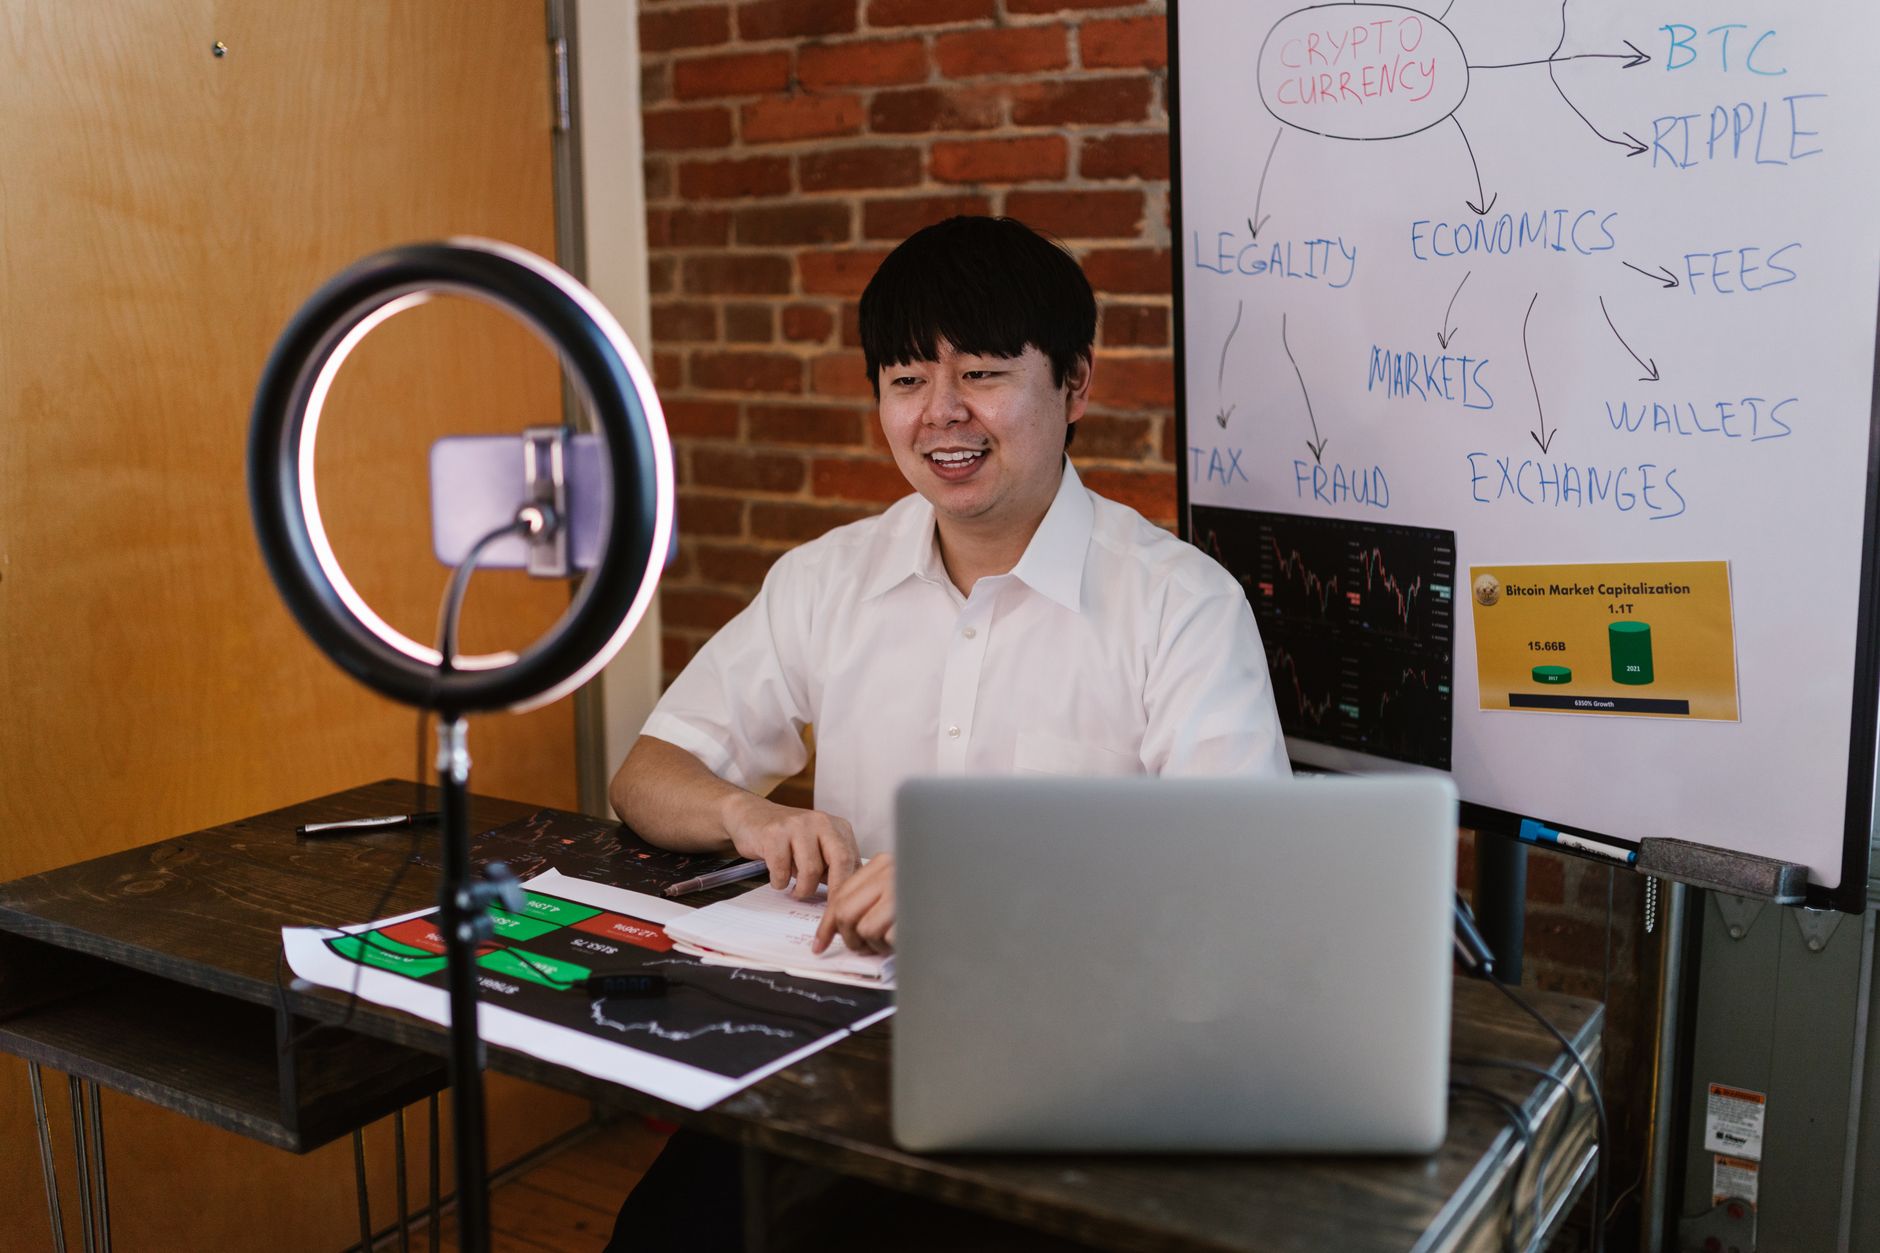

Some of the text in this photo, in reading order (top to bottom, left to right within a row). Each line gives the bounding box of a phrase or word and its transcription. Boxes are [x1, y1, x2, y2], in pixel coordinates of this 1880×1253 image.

[1281, 16, 1424, 69] CRYPTO
[1658, 23, 1788, 76] BTC
[1276, 57, 1437, 105] CURRENCY
[1652, 93, 1828, 170] RIPPLE
[1194, 230, 1357, 288] LEGALITY
[1411, 209, 1618, 261] ECONOMICS
[1683, 242, 1802, 295] FEES
[1367, 344, 1494, 410] MARKETS
[1606, 397, 1798, 442] WALLETS
[1189, 446, 1249, 487] TAX
[1293, 459, 1390, 509] FRAUD
[1466, 452, 1686, 520] EXCHANGES
[1505, 582, 1691, 598] Bitcoin Market Capitalization
[1608, 603, 1634, 614] 1.1T
[1527, 641, 1567, 652] 15.66B
[1593, 700, 1615, 709] Growth
